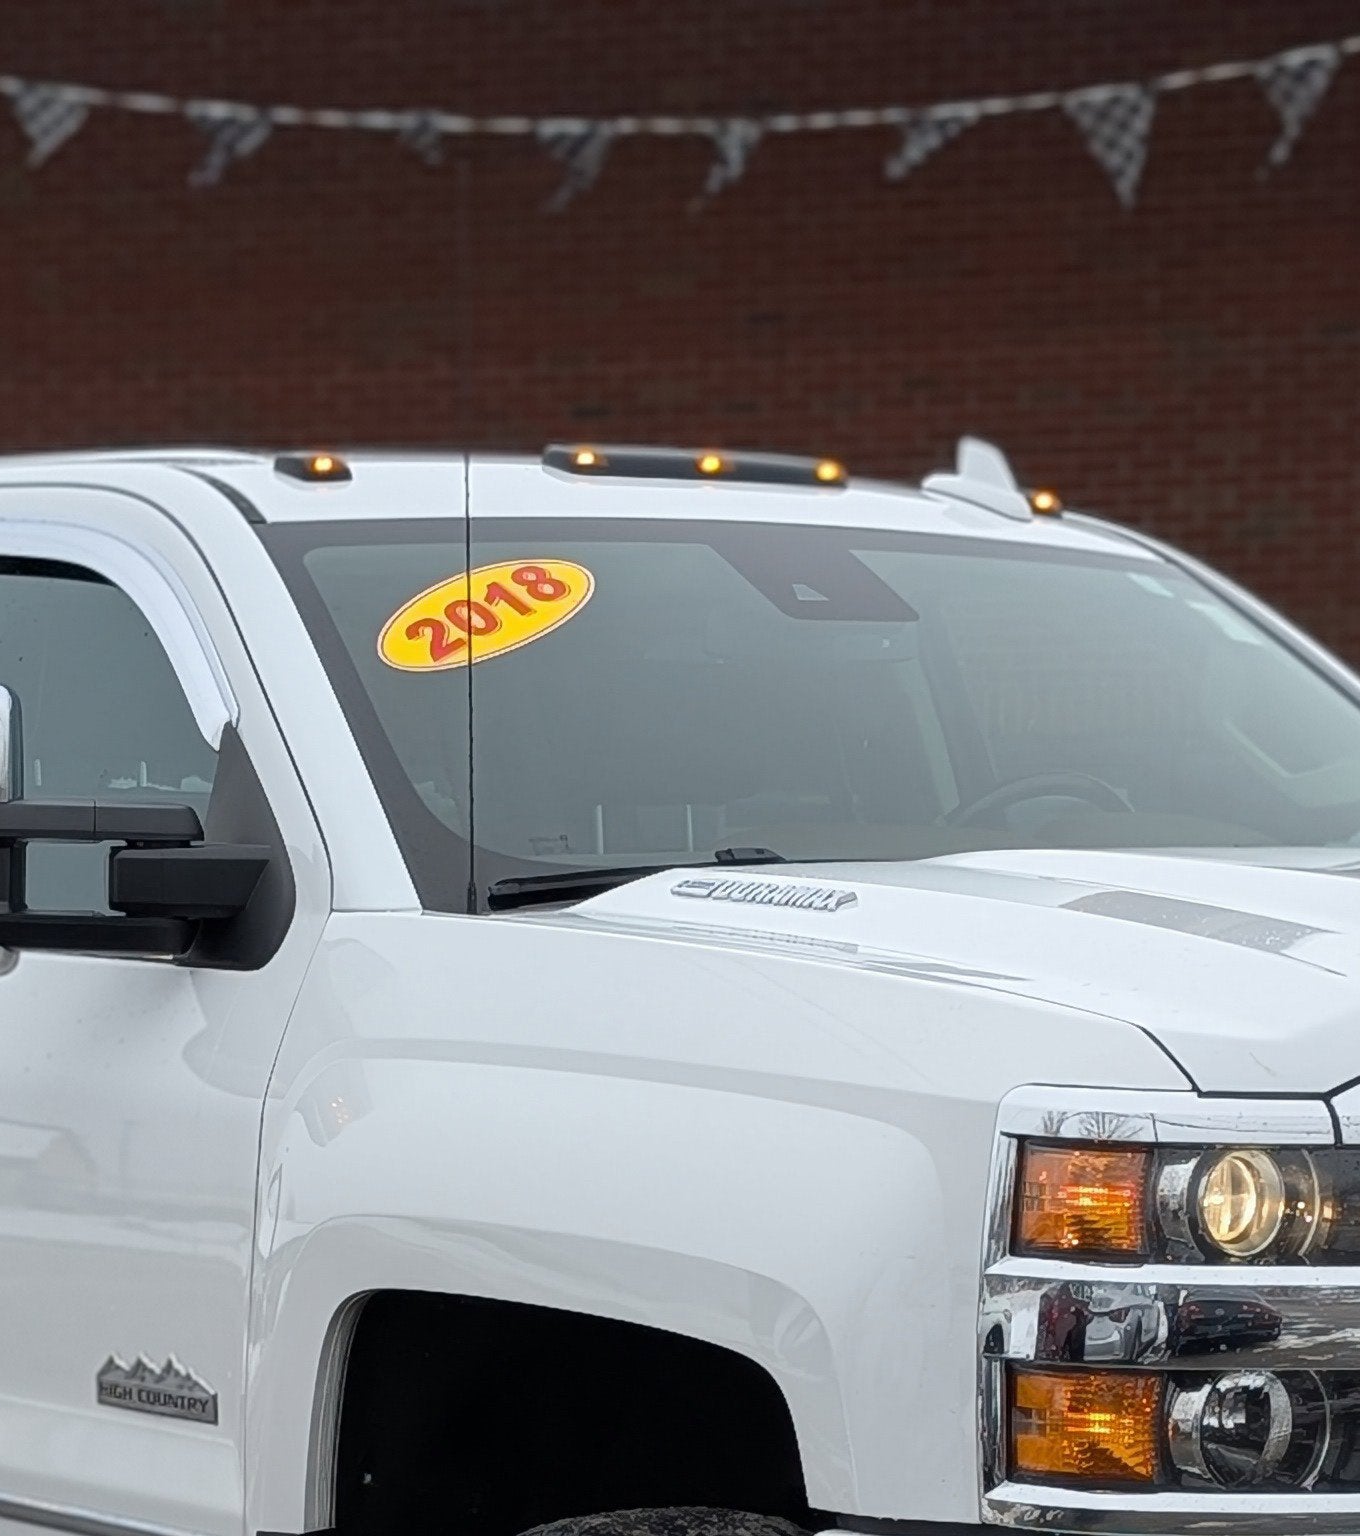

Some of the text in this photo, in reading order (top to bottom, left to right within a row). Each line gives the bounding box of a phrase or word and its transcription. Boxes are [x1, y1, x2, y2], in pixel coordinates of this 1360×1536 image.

[405, 565, 572, 663] 2018
[100, 1383, 209, 1413] HIGH COUNTRY
